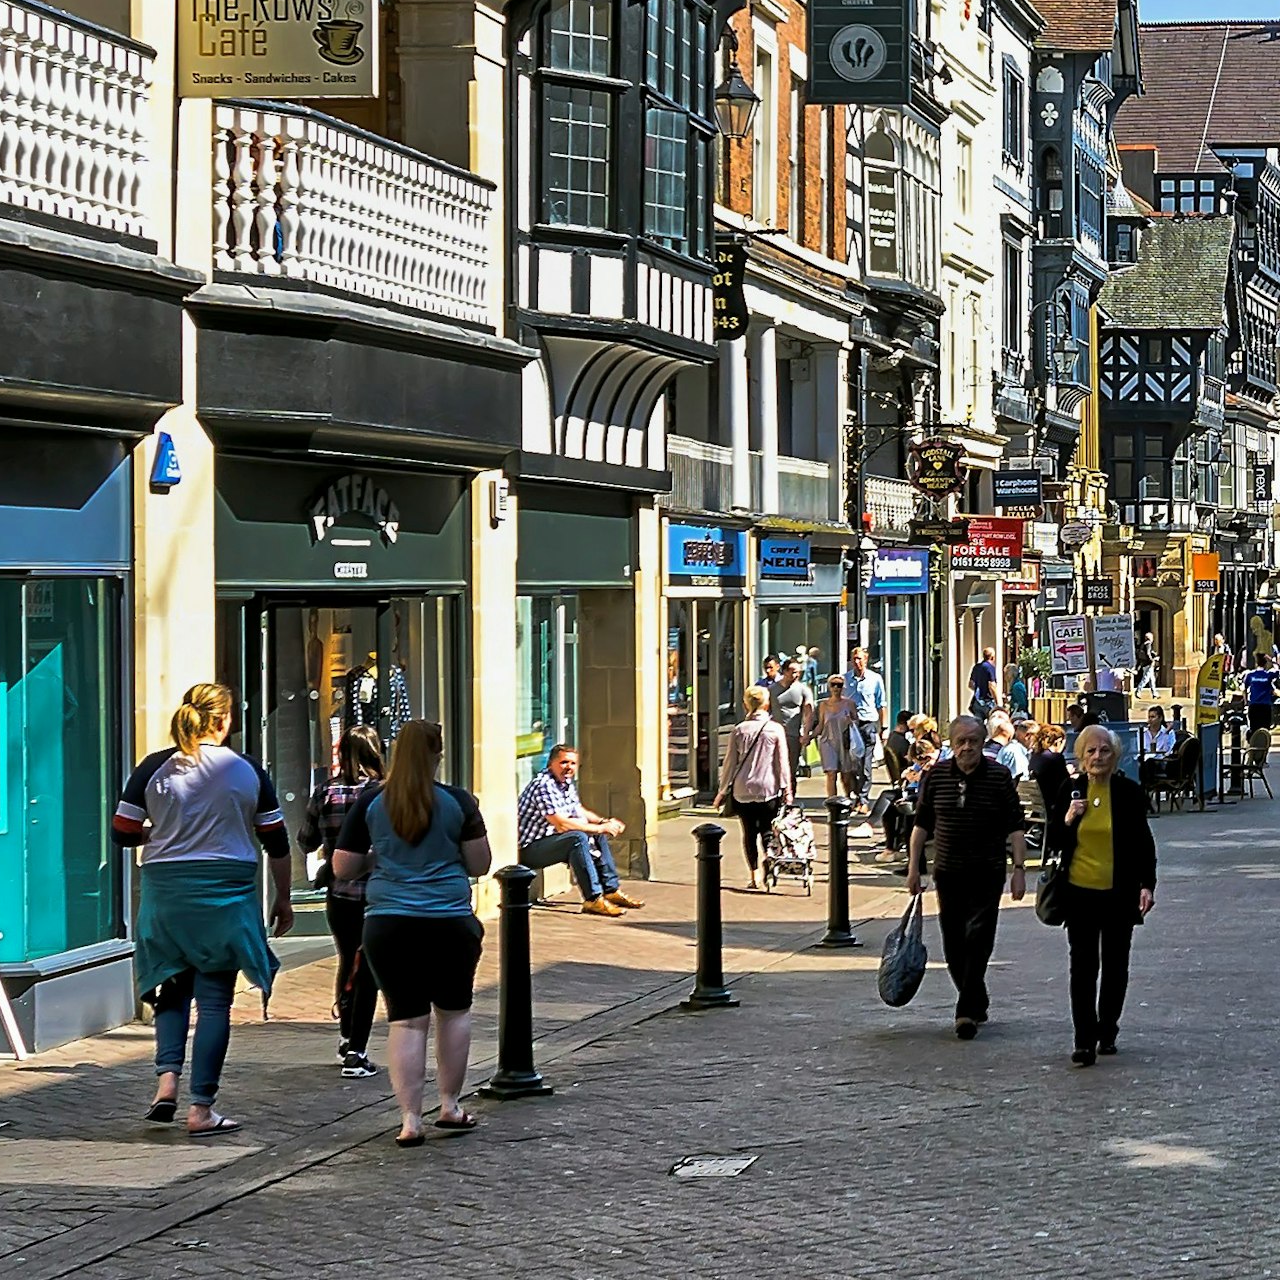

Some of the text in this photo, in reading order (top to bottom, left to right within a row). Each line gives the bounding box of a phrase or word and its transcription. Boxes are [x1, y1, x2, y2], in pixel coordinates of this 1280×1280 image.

[198, 13, 268, 57] Café
[192, 72, 356, 84] Snacks Sandwiches Cakes
[999, 479, 1038, 488] Carphone
[1255, 467, 1266, 499] next
[952, 545, 1010, 556] FOR SALE
[763, 557, 807, 568] NERO
[952, 558, 973, 567] 0161
[974, 558, 989, 568] 235
[1197, 580, 1214, 588] SOLE
[1055, 627, 1083, 638] CAFE
